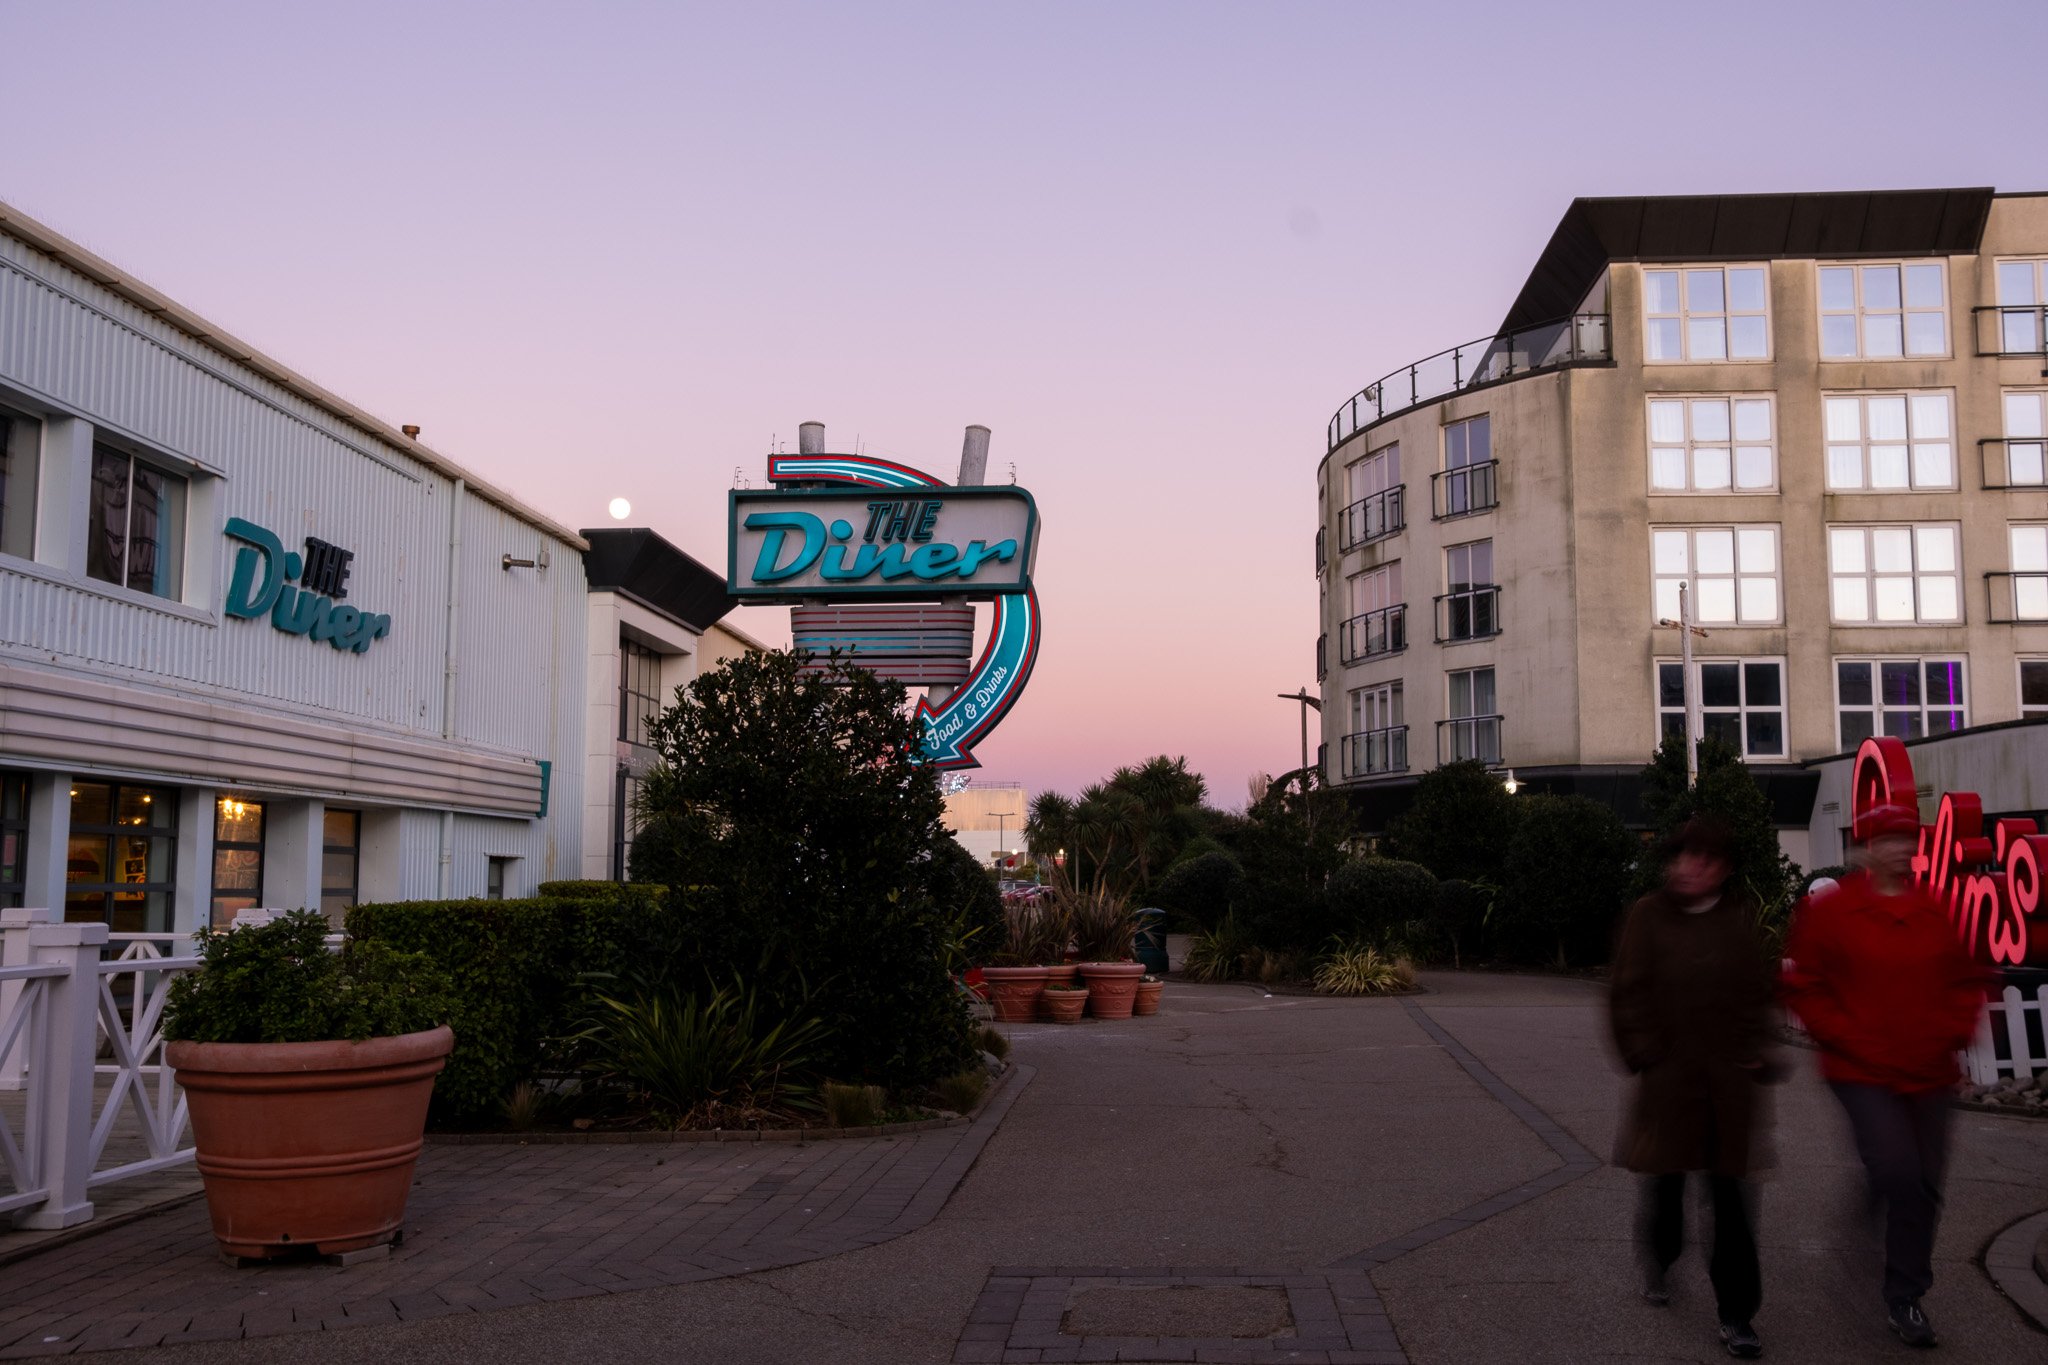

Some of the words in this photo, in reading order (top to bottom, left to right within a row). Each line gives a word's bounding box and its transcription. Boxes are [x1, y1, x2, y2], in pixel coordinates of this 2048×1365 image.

[744, 511, 1017, 582] Diner
[864, 501, 942, 541] THE
[224, 517, 391, 653] Diner
[301, 537, 354, 598] THE
[926, 713, 963, 750] Food
[964, 703, 977, 719] &
[976, 666, 1007, 708] Drinks
